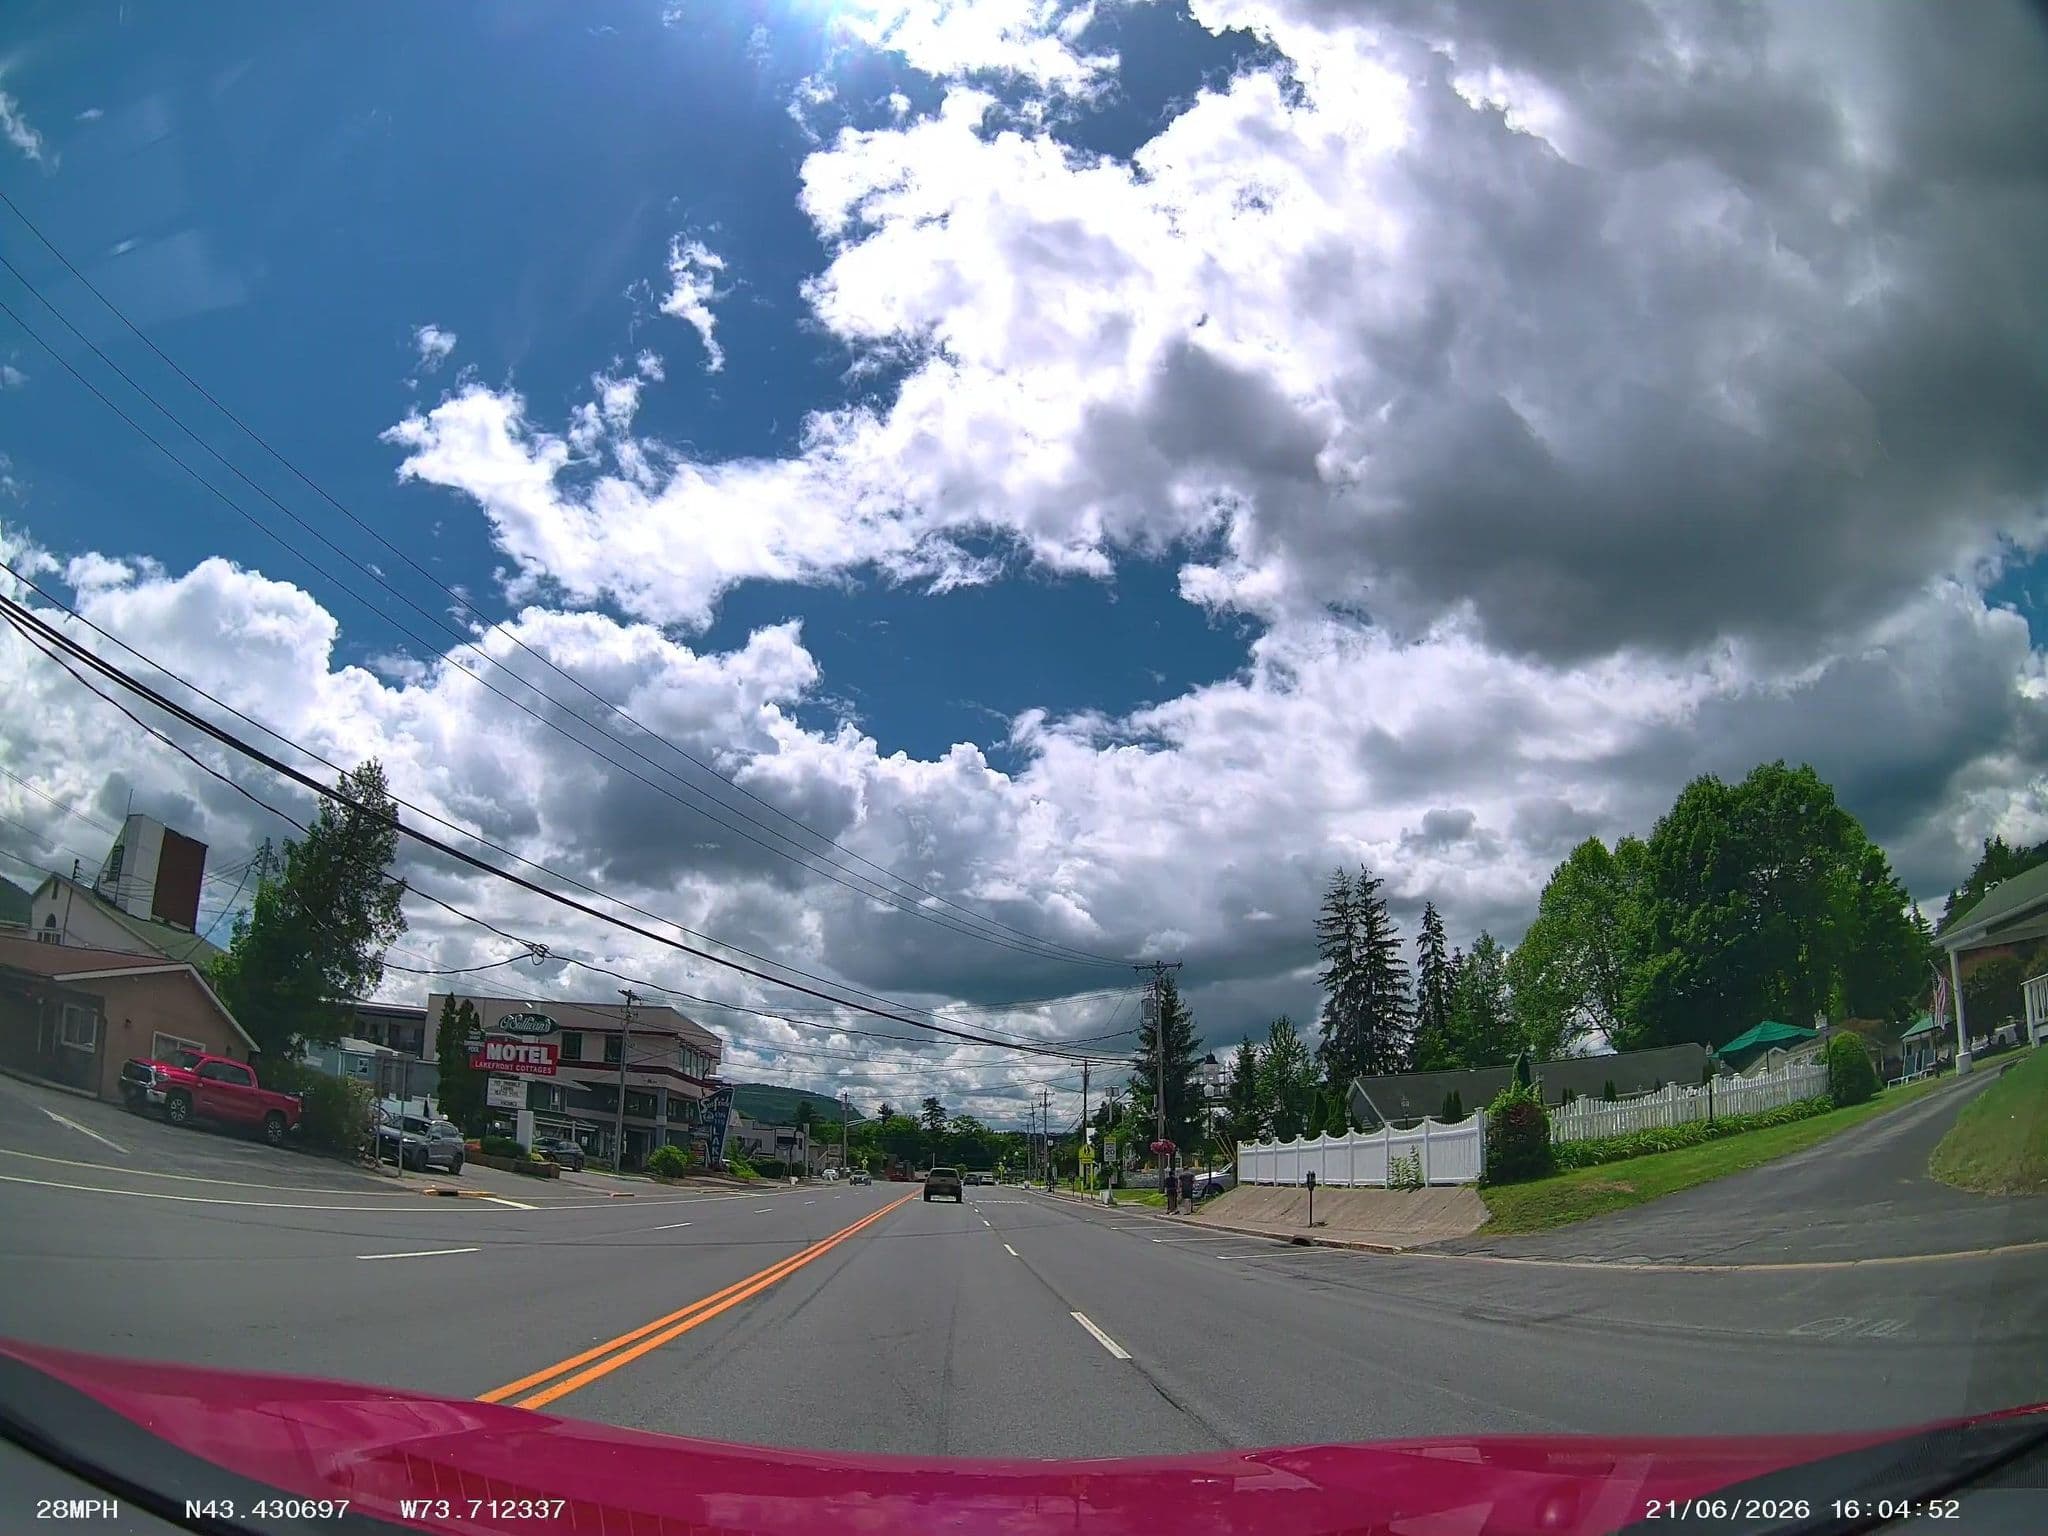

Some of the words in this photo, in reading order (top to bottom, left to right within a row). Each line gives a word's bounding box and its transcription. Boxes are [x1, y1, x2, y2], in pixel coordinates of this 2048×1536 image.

[487, 1043, 552, 1065] MOTEL
[475, 1061, 513, 1071] LAKEFRONT
[516, 1065, 552, 1074] COTTAGES
